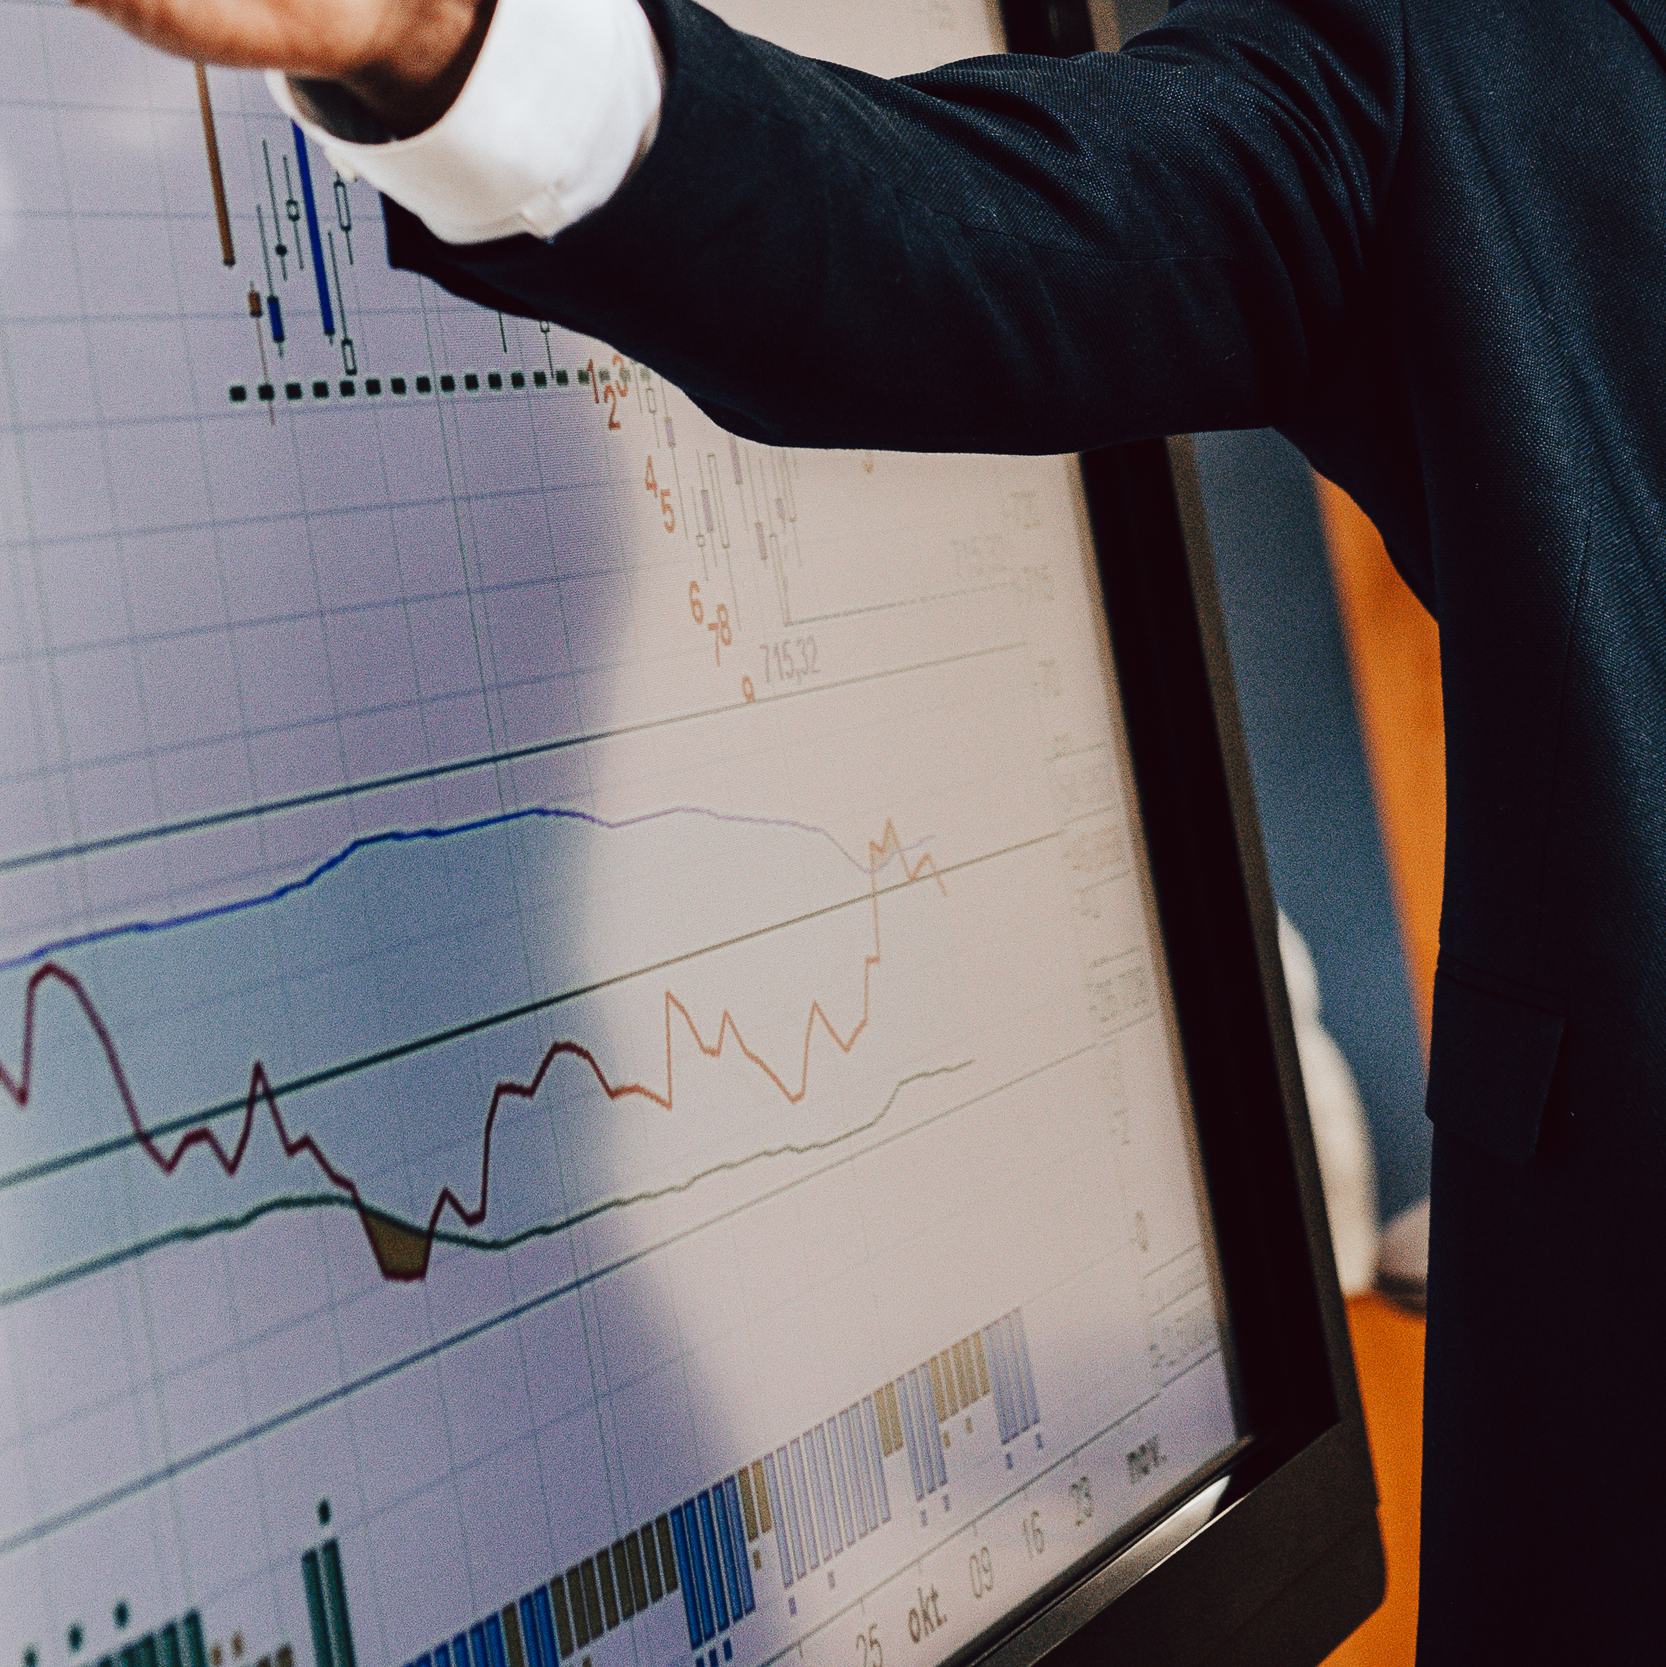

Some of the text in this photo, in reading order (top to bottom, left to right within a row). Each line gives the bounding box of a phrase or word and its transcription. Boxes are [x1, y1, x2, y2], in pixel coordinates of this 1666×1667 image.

[587, 359, 600, 404] 1
[603, 385, 621, 431] 2
[644, 454, 659, 499] 4
[659, 488, 676, 534] 5
[688, 580, 705, 626] 6
[716, 603, 733, 647] 8
[707, 622, 724, 667] 7
[759, 636, 822, 685] 715,32
[968, 1546, 995, 1600] 09
